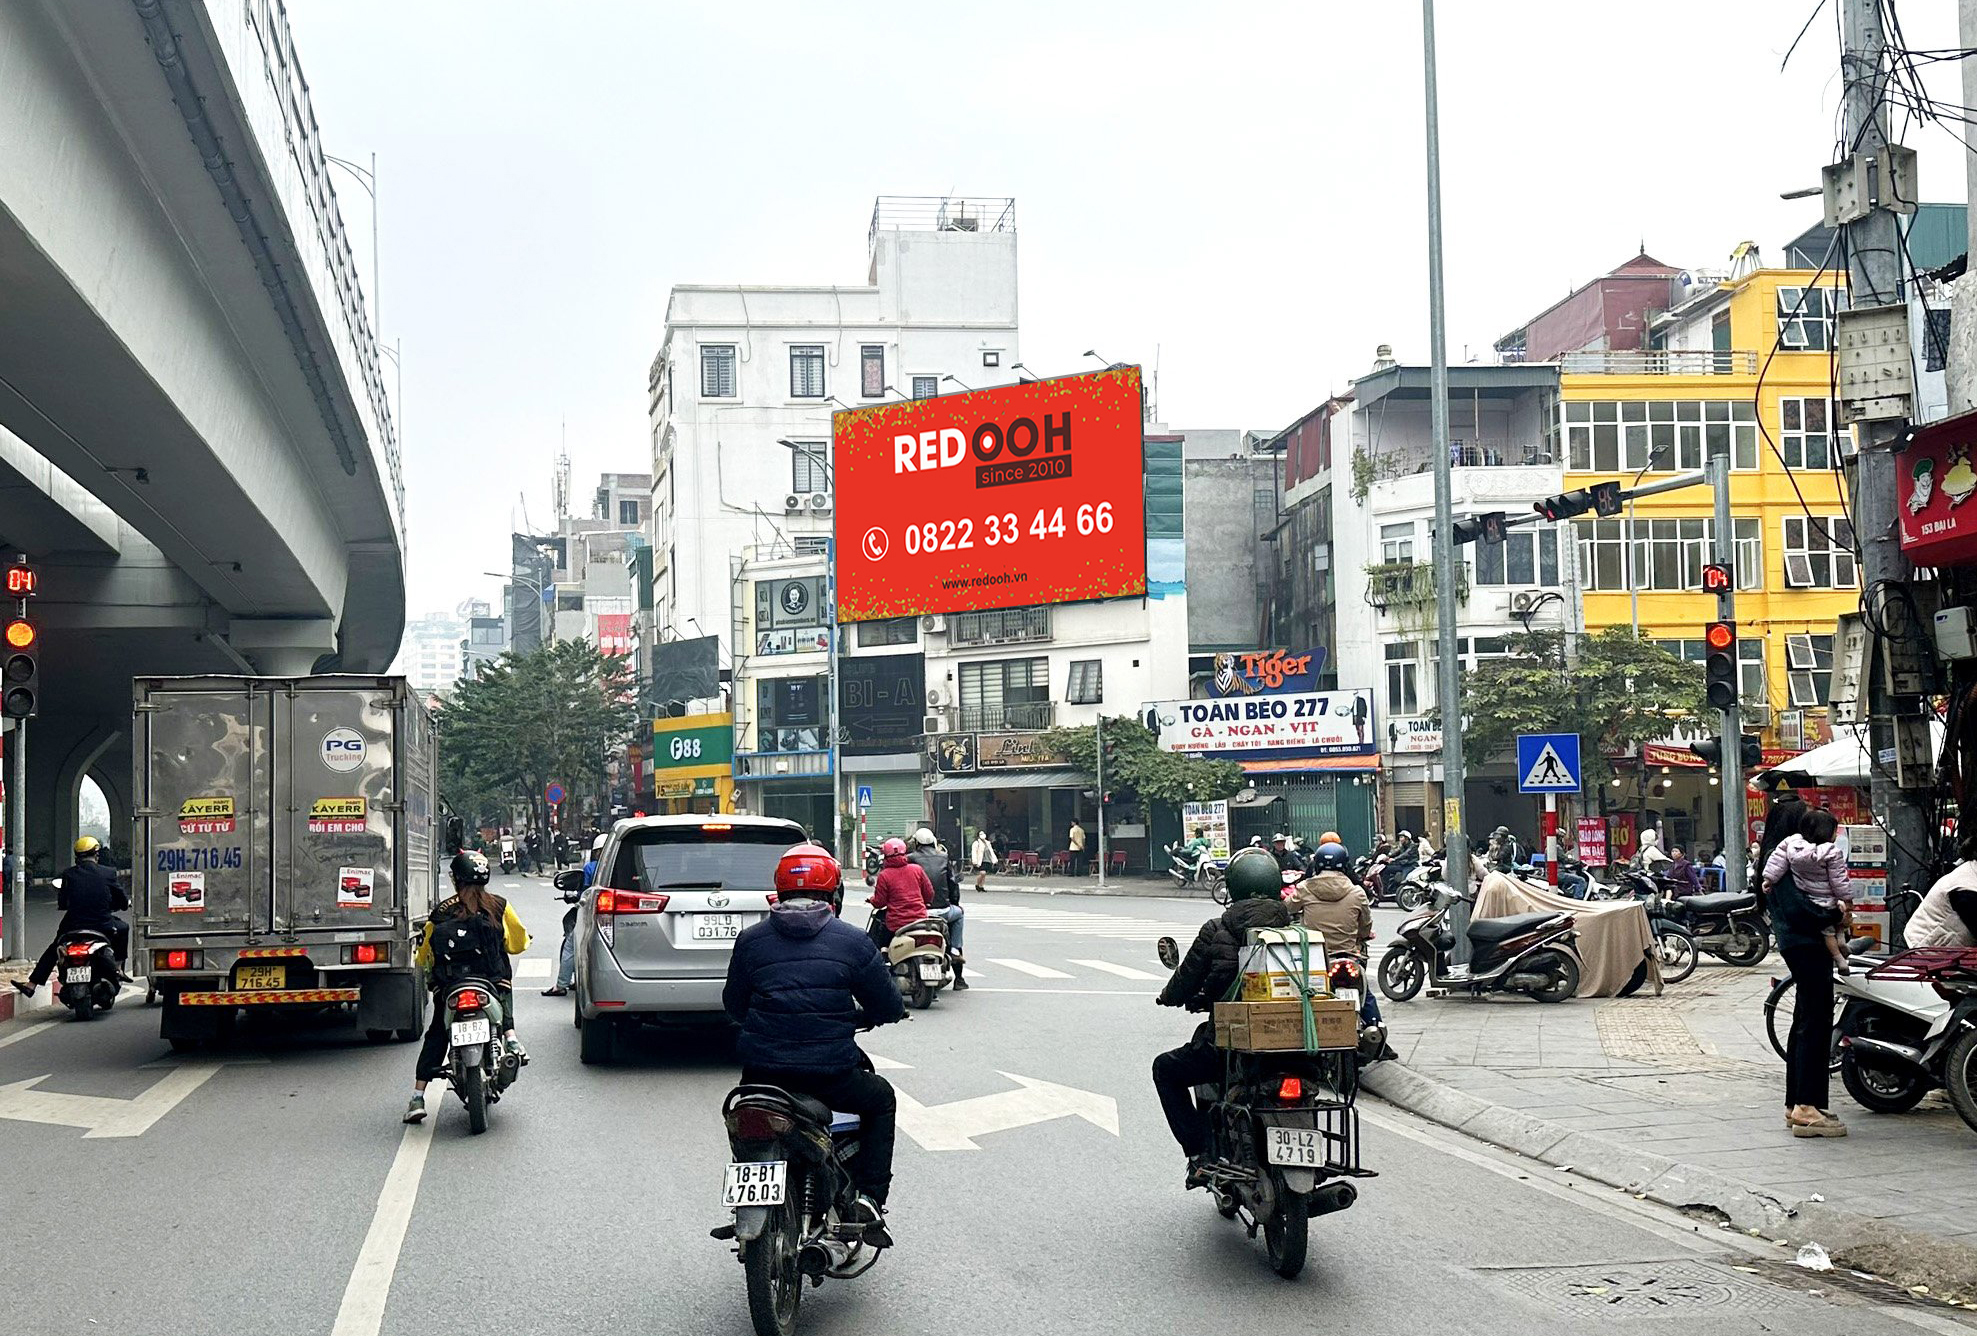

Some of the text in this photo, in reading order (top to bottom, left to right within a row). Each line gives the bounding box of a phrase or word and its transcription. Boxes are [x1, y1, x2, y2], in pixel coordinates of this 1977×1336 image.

[894, 411, 1072, 474] RED OOH
[982, 459, 1066, 484] since 2010
[905, 501, 1114, 555] 0822 33 44 66
[1921, 522, 1933, 535] 153
[1947, 517, 1957, 529] LA
[9, 569, 32, 590] 04
[942, 572, 1028, 590] www.redooh.vn
[1708, 569, 1728, 588] 04
[1240, 649, 1312, 688] Tiger
[1180, 700, 1239, 723] TOÀN
[1294, 698, 1329, 717] 277
[1191, 721, 1319, 738] GÀ NGAN VỊT
[1410, 734, 1437, 743] NGAN
[326, 740, 362, 751] PG
[670, 736, 701, 760] F88
[326, 753, 362, 762] Trucking
[1214, 803, 1225, 815] 277
[327, 823, 343, 832] EM
[345, 823, 364, 832] CHO
[346, 868, 372, 876] Enimac
[698, 926, 737, 938] 031.76
[250, 966, 272, 977] 29H
[1275, 1130, 1314, 1148] 30-L2
[1276, 1146, 1315, 1164] 4719
[735, 1164, 776, 1184] 18-B1
